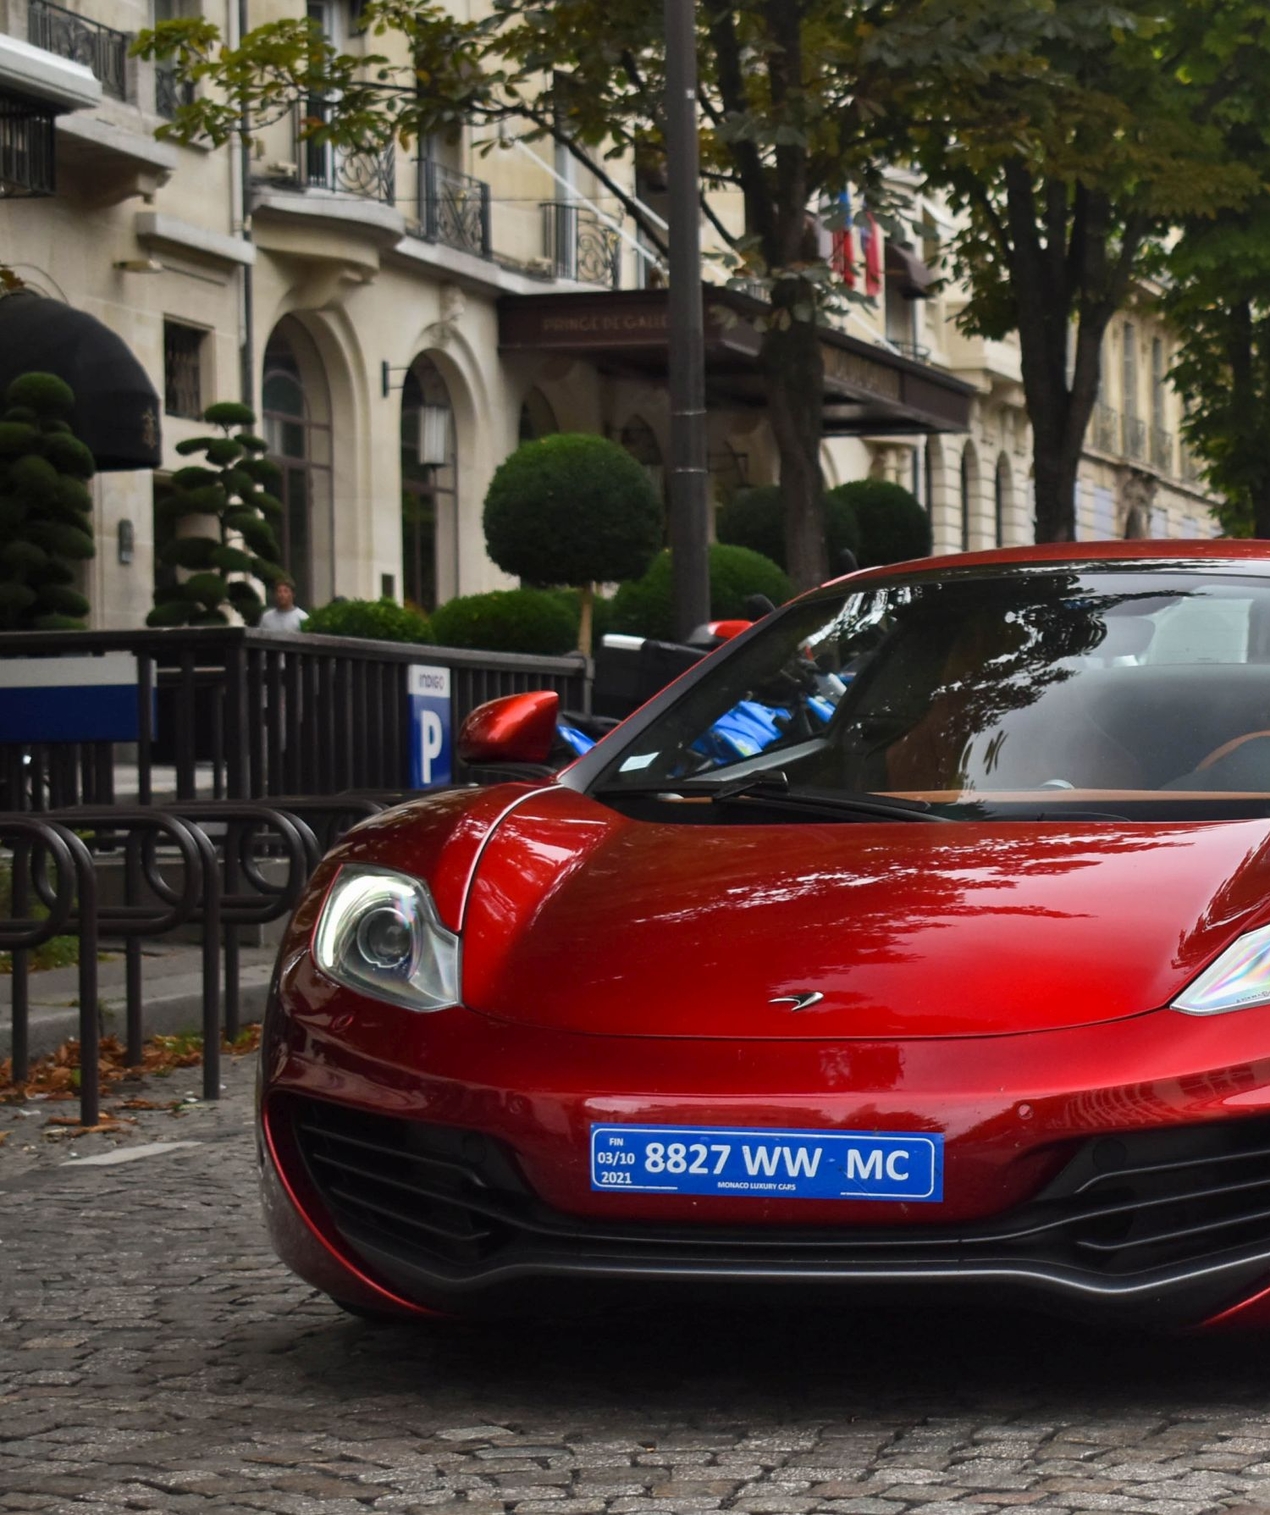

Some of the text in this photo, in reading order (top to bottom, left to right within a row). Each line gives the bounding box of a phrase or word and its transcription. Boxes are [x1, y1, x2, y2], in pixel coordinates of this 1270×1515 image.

[543, 315, 598, 331] PRINCE
[603, 315, 620, 330] DE
[419, 673, 445, 690] INDIGO
[422, 709, 443, 784] P
[609, 1137, 624, 1147] FIN
[597, 1151, 635, 1167] 03/10
[644, 1142, 910, 1181] 8827 WW MC
[601, 1171, 632, 1184] 2021
[717, 1181, 749, 1190] MONACO
[750, 1182, 777, 1191] LUXURY
